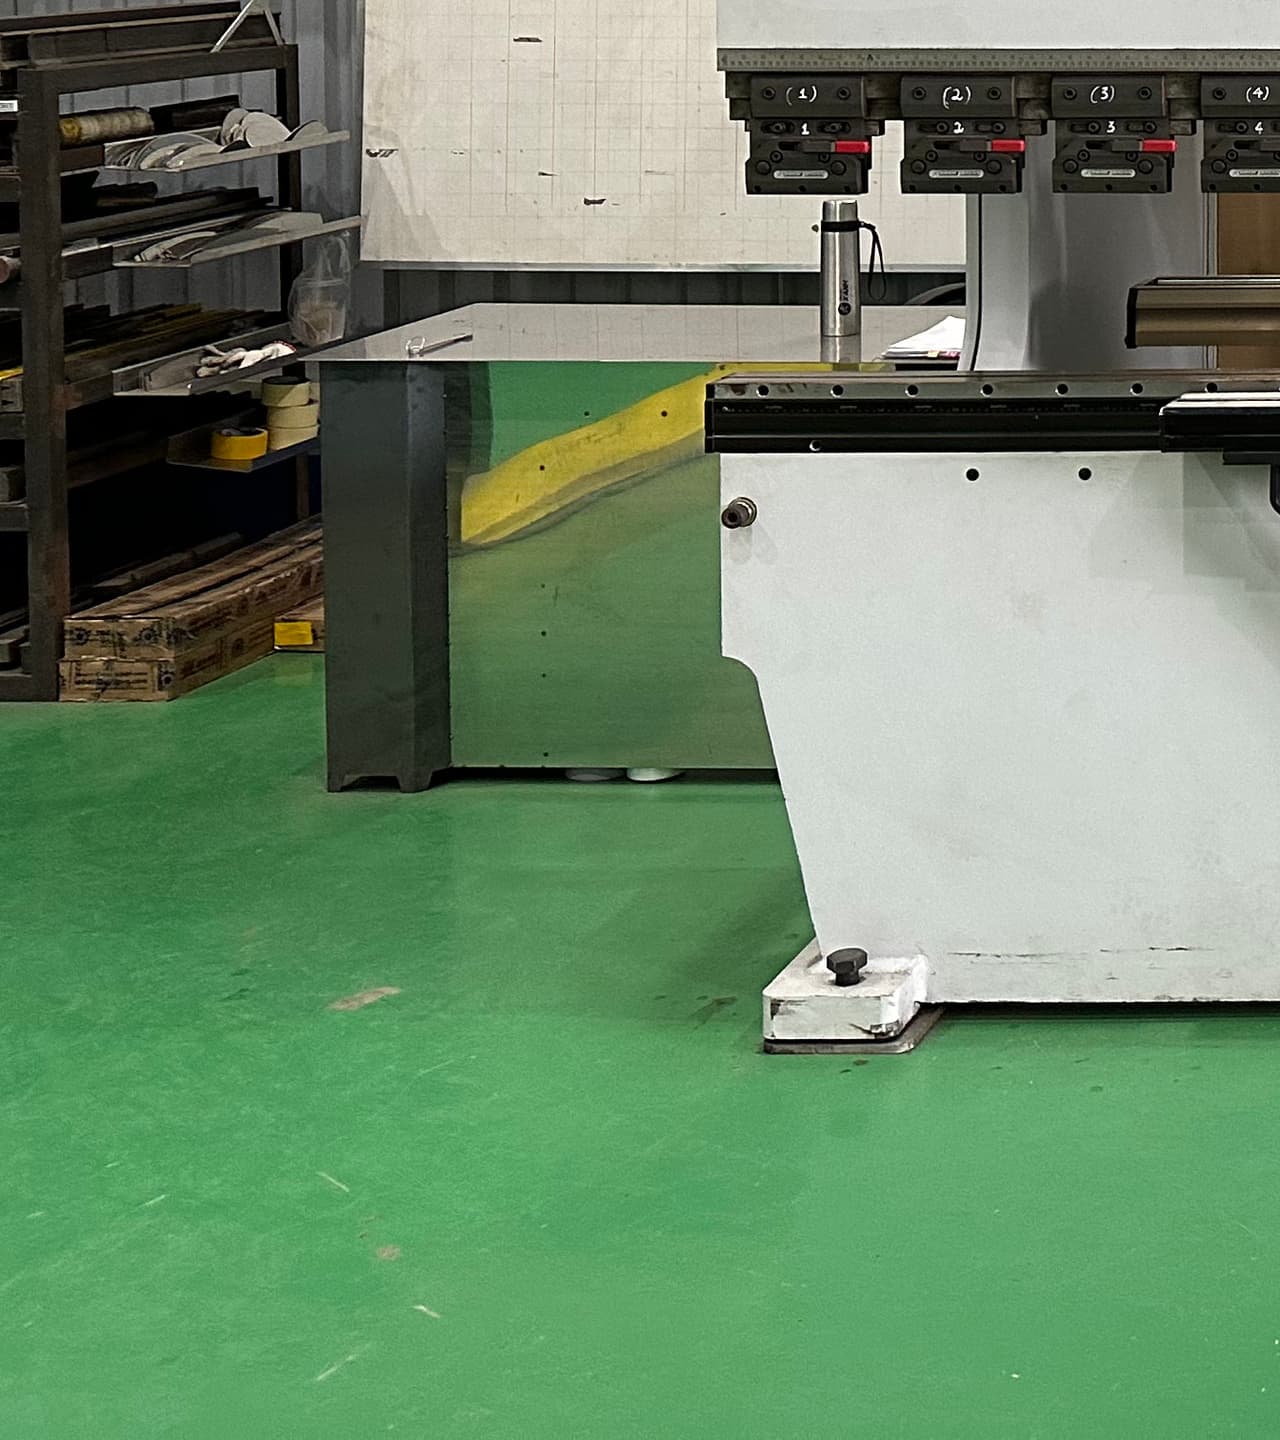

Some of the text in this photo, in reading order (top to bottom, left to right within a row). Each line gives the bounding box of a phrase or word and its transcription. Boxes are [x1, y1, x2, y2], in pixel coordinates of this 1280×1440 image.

[801, 122, 810, 136] 1
[953, 122, 965, 134] 2
[1106, 121, 1116, 134] 3
[1254, 121, 1263, 135] 4
